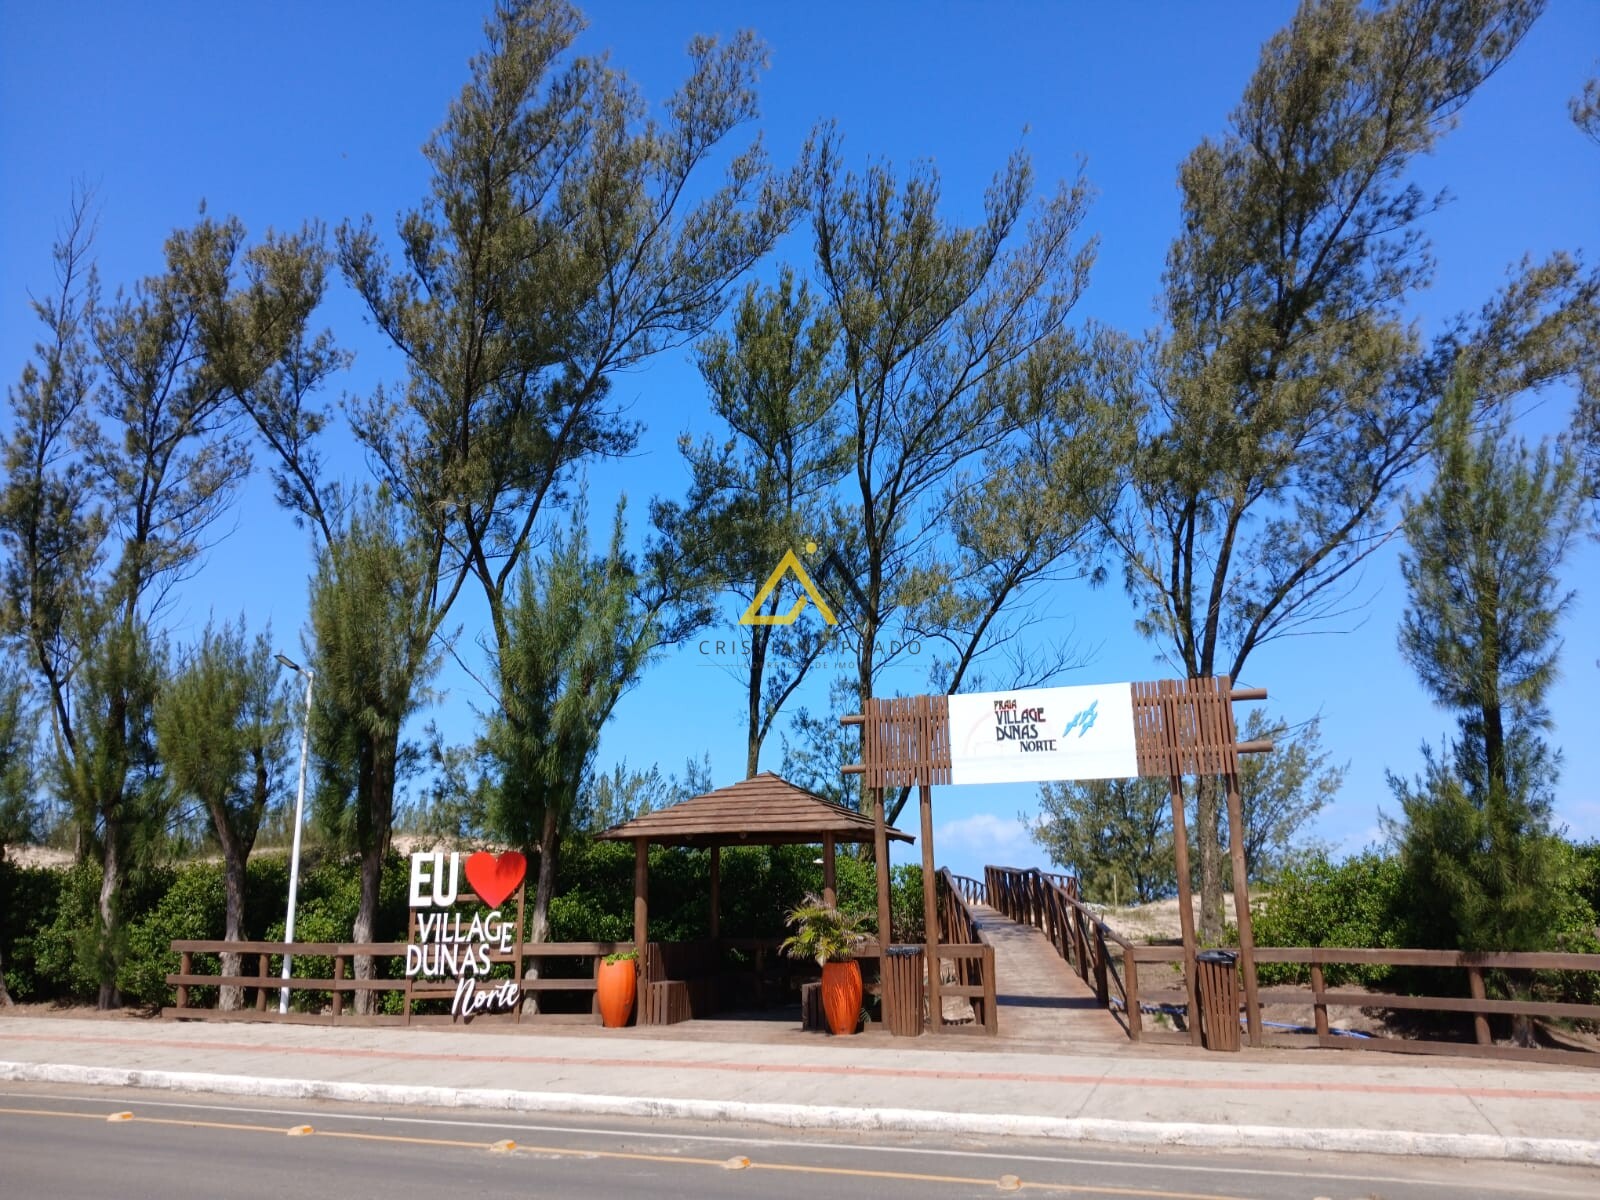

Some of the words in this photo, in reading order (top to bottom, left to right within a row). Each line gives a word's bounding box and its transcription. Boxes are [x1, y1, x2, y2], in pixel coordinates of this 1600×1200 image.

[994, 699, 1017, 710] PRAIA
[994, 707, 1047, 725] VILLAGE
[995, 724, 1039, 741] DUNAS
[1020, 739, 1057, 752] NORTE
[409, 852, 460, 907] EU
[417, 911, 514, 953] VILLAGE
[405, 944, 491, 976] DUNAS
[451, 977, 520, 1017] Norte
